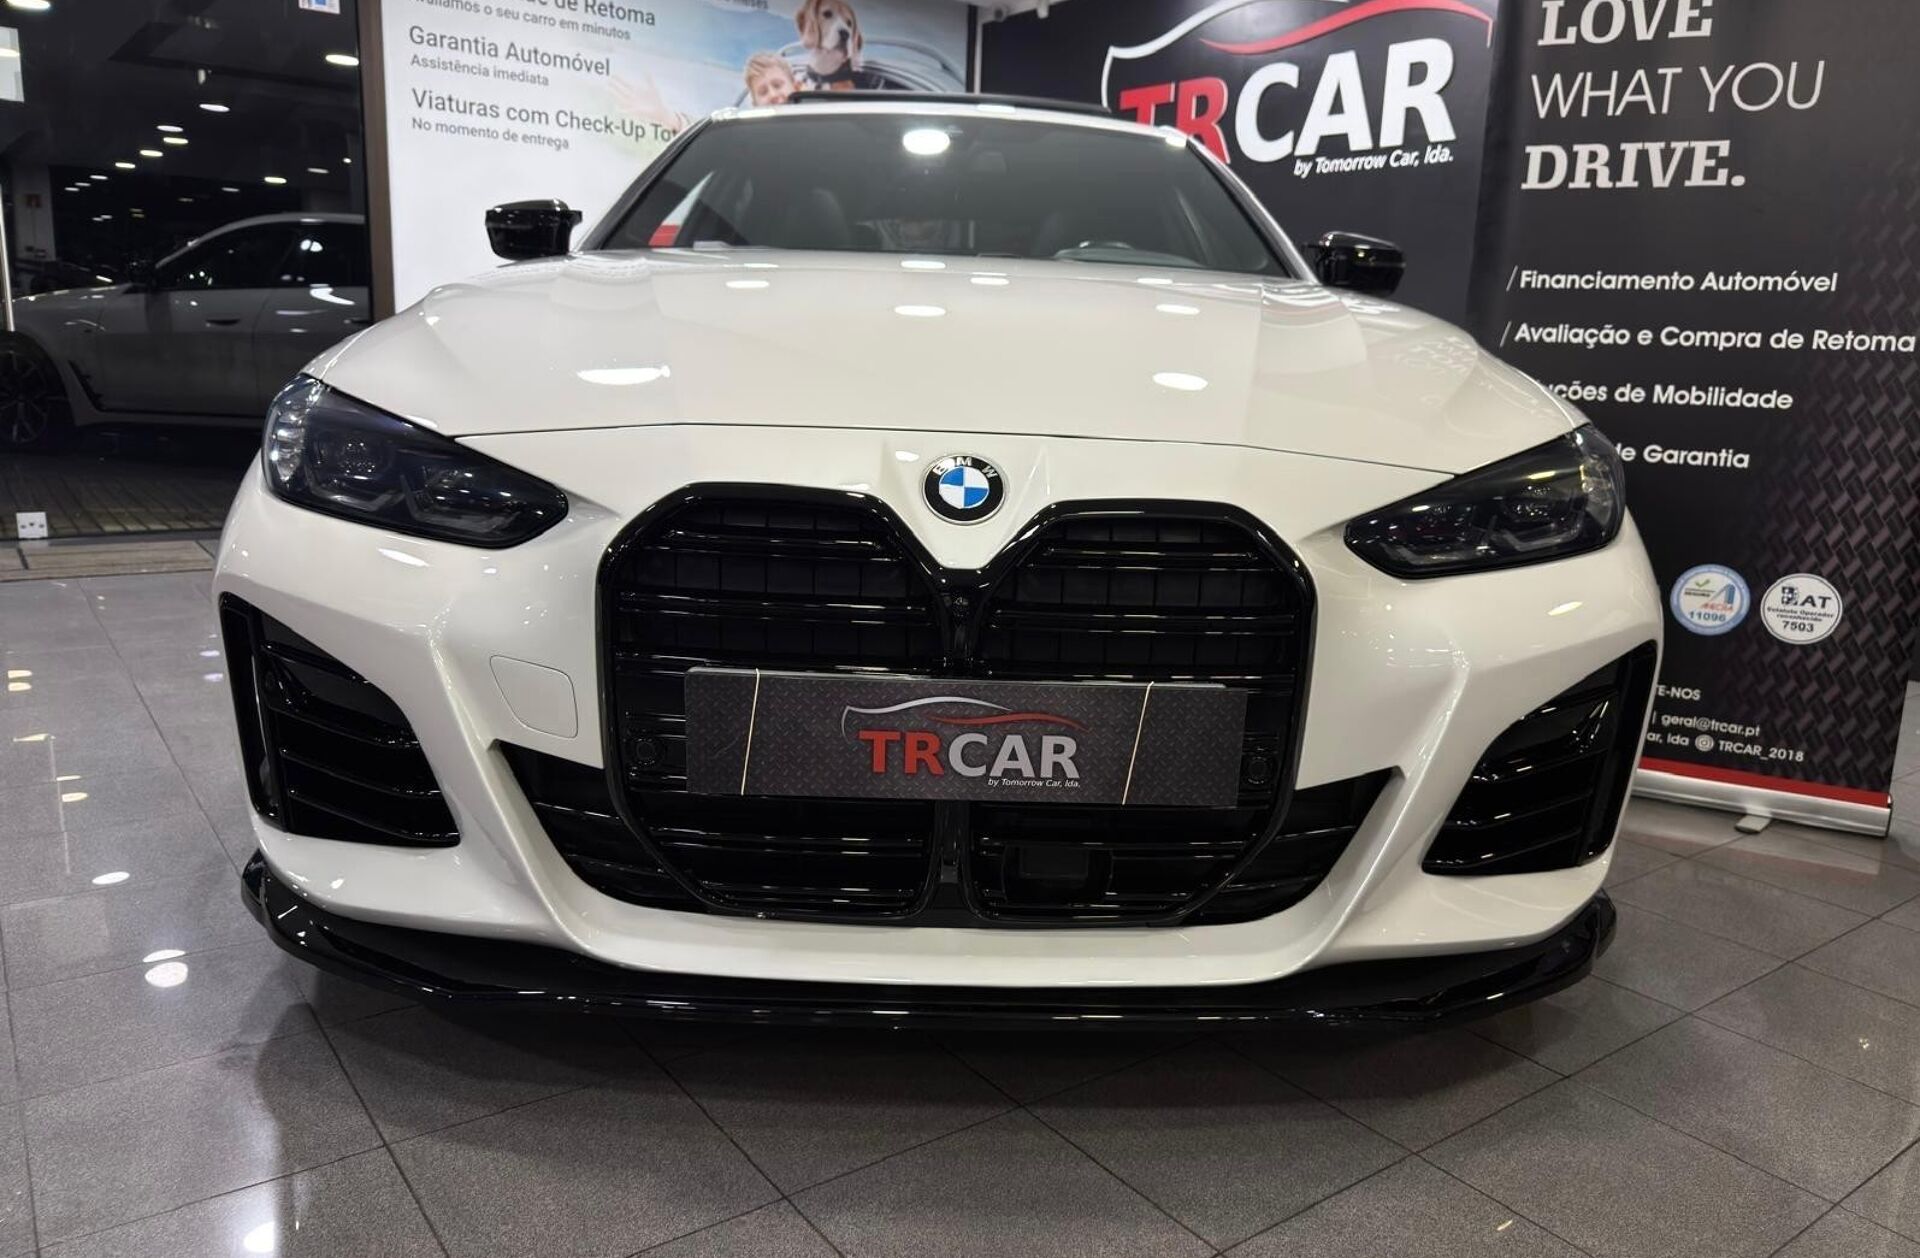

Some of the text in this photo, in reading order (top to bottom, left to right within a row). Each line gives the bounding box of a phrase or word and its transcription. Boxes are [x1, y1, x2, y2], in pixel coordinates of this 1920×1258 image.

[415, 0, 631, 40] aamos o seu carro em minutos
[584, 0, 655, 26] Retoma
[1537, 0, 1714, 46] LOVE
[409, 25, 611, 76] Garantia Automóvel
[410, 54, 549, 86] Assistência imediata
[1119, 38, 1456, 164] TRCAR
[1531, 60, 1826, 119] WHAT YOU
[411, 87, 500, 118] Viaturas
[506, 105, 549, 125] com
[555, 109, 646, 142] Check-Up
[412, 118, 569, 151] No momento de entrega
[1293, 149, 1313, 179] by
[1315, 153, 1388, 175] Tomorrow
[1389, 149, 1420, 168] Car,
[1521, 140, 1746, 190] DRIVE.
[1700, 270, 1839, 292] Automóvel
[1636, 329, 1653, 346] e
[1660, 326, 1762, 351] Compra
[1769, 328, 1804, 350] de
[1812, 330, 1917, 352] Retoma
[1614, 383, 1646, 403] de
[1652, 384, 1793, 409] Mobilidade
[1643, 444, 1750, 468] Garantia
[1656, 685, 1700, 700] E-NOS
[1661, 715, 1760, 737] geral@trcar.pt
[858, 730, 1081, 778] TRCAR
[1718, 740, 1804, 762] TRCAR_2018
[988, 778, 999, 788] by
[1002, 778, 1044, 788] Tomorrow
[1046, 779, 1063, 789] Car,
